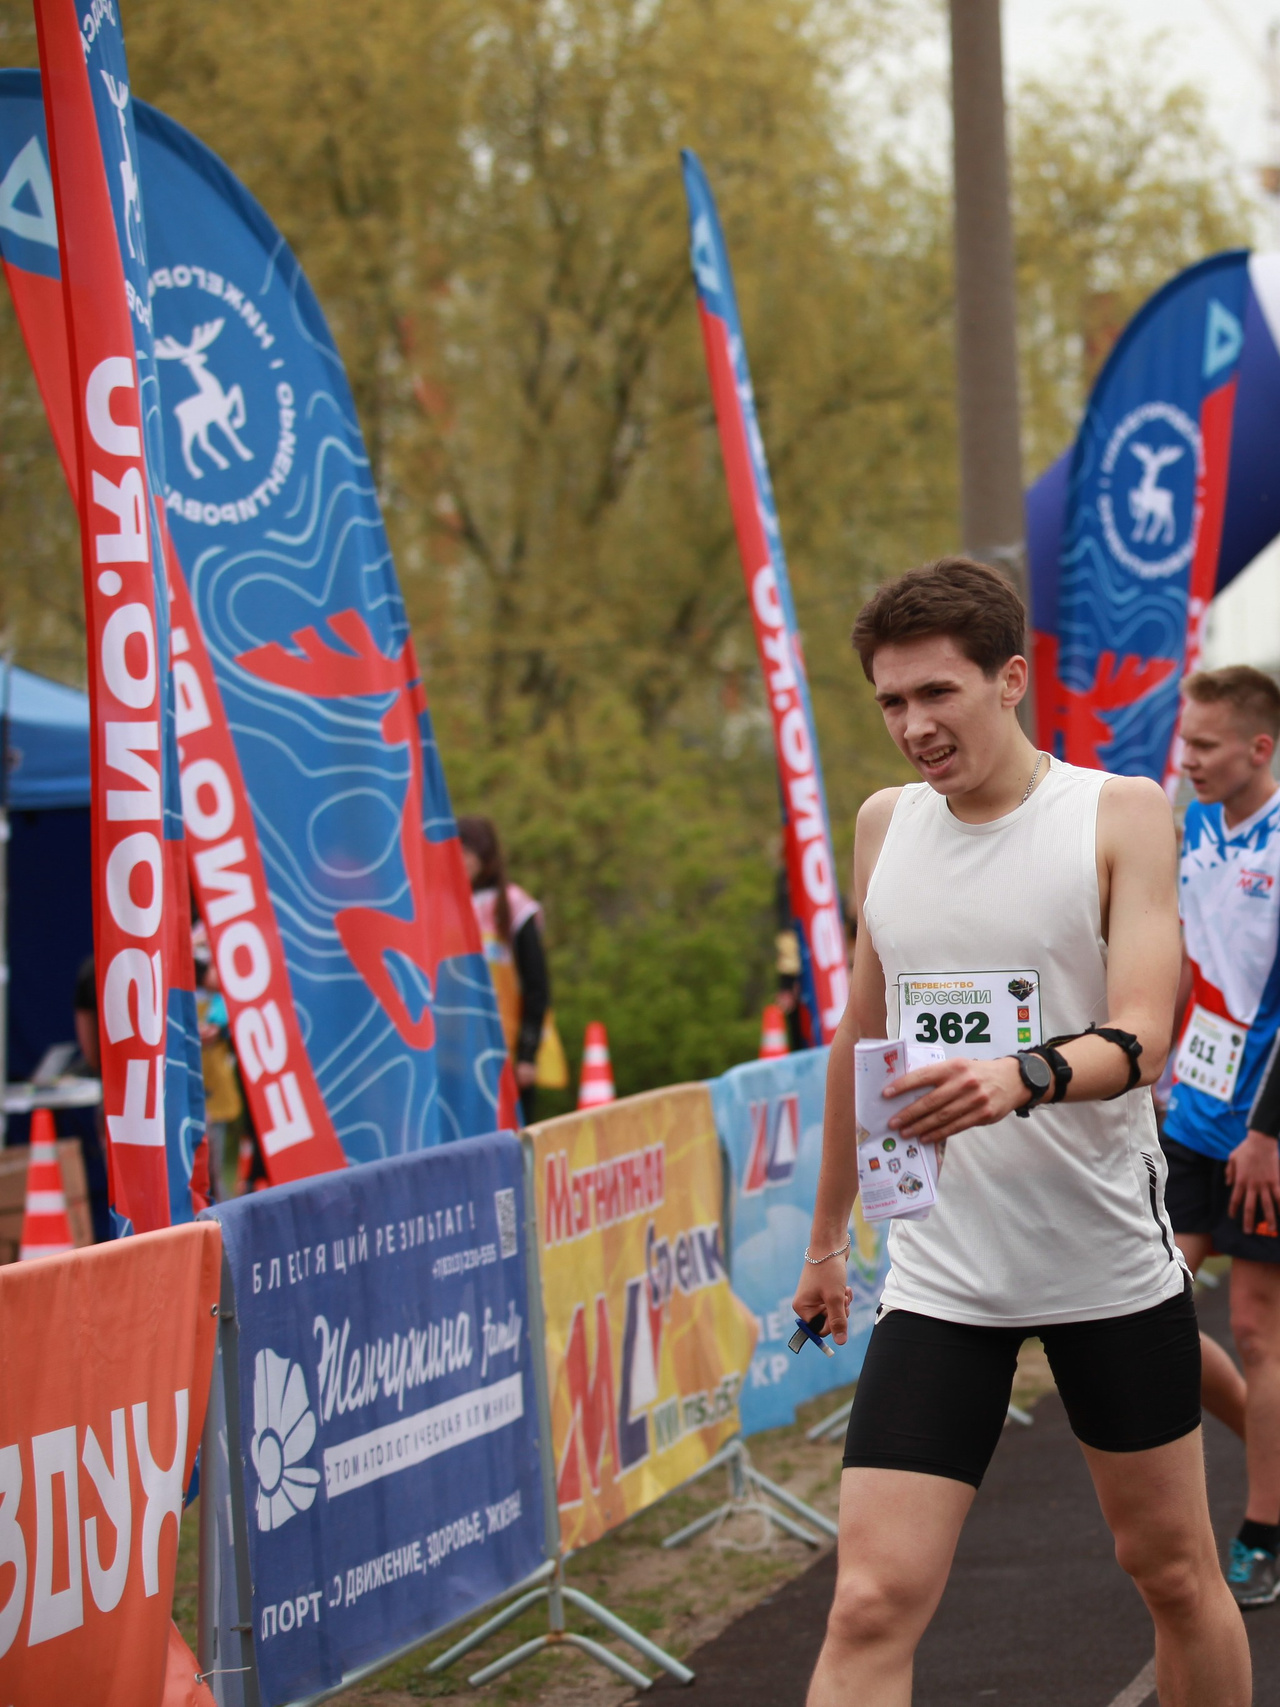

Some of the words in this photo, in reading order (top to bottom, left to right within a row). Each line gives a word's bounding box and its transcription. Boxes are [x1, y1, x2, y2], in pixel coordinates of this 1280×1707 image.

[910, 981, 974, 990] ПЕРВЕНСТВО
[911, 990, 991, 1005] РОССИИ
[915, 1011, 991, 1044] 362
[313, 1314, 473, 1427] Жемчужина
[345, 1540, 427, 1608] ДВИЖЕНИЕ,
[426, 1511, 485, 1569] ЗДОРОВЬЕ,
